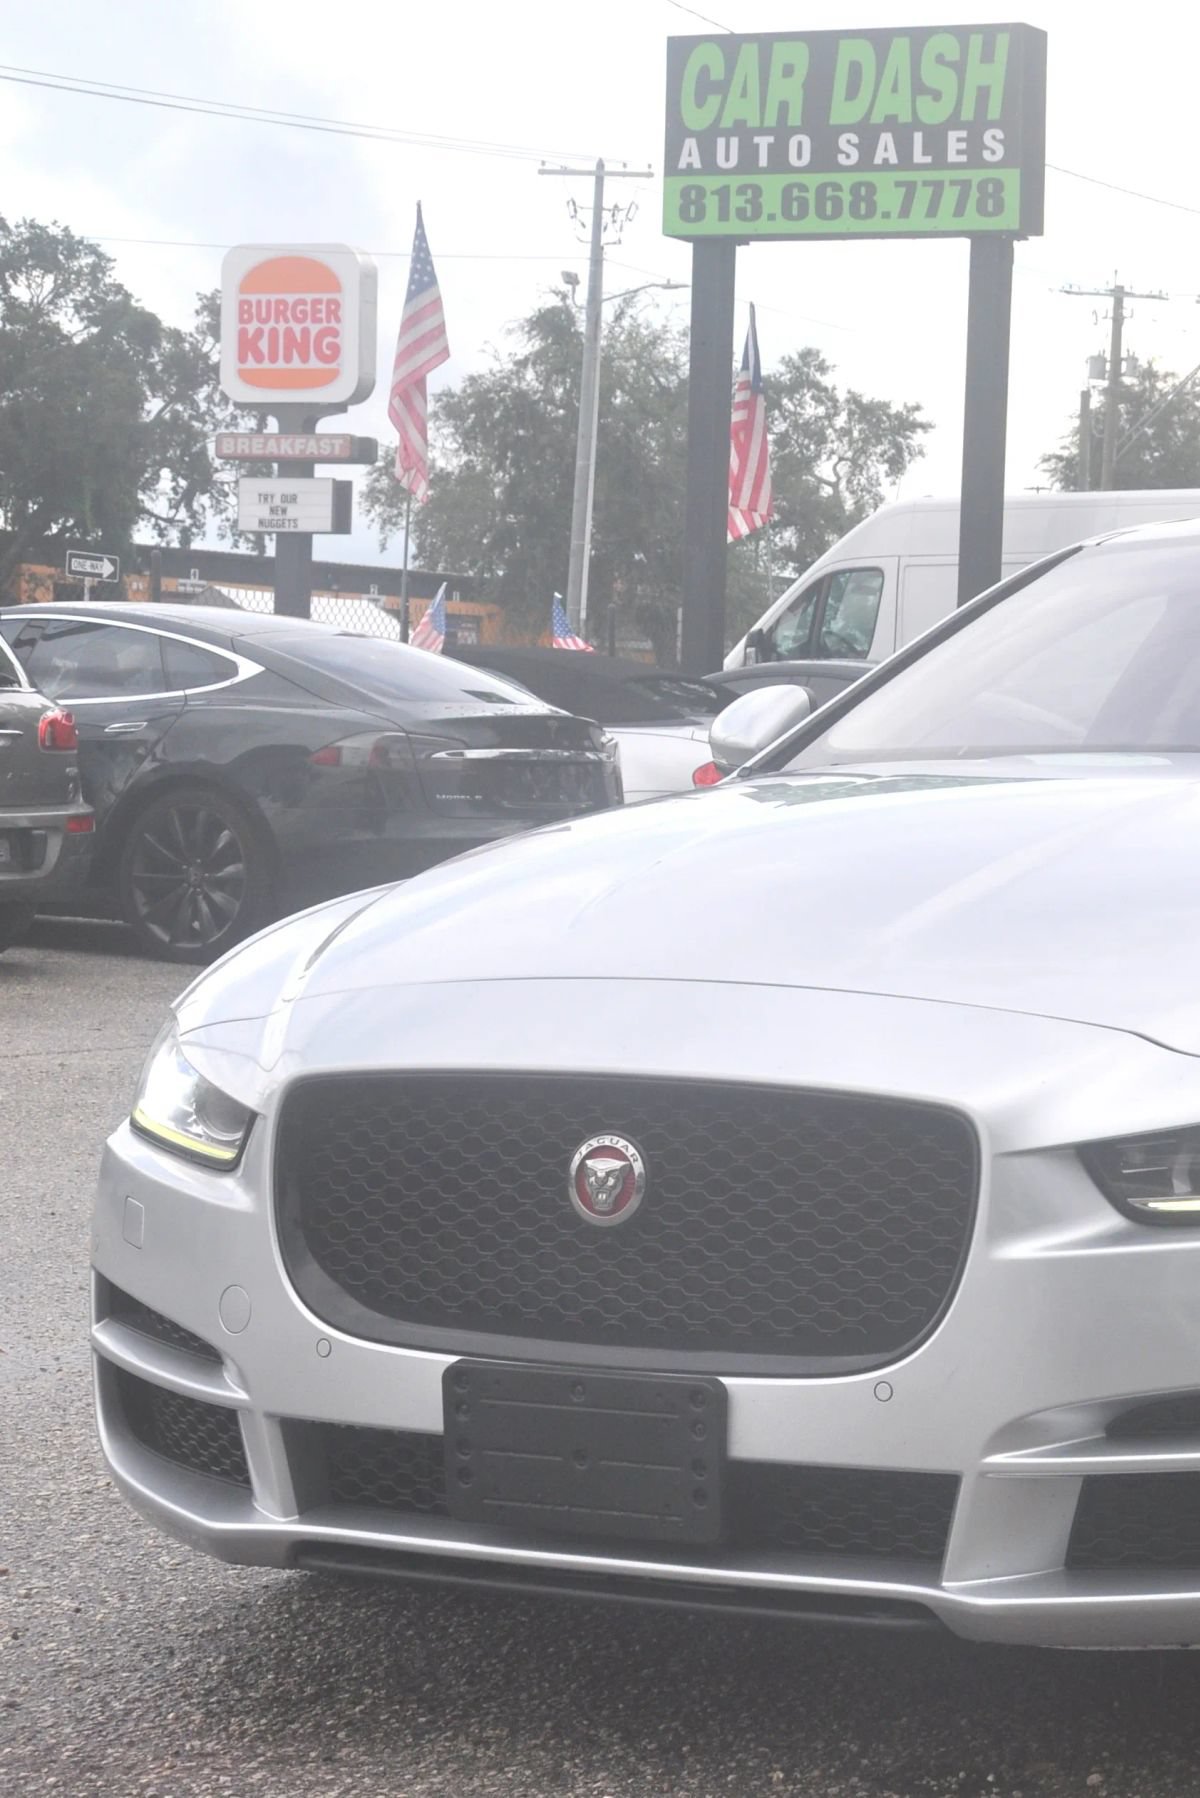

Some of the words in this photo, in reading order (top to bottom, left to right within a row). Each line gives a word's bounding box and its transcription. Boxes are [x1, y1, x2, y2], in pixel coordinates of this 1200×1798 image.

[679, 41, 810, 131] CAR
[829, 32, 1011, 125] DASH
[677, 134, 812, 170] AUTO
[836, 128, 1006, 166] SALES
[678, 177, 1006, 224] 813.668.7778
[238, 298, 342, 325] BURGER
[238, 326, 342, 365] KING
[221, 437, 345, 456] BREAKFAST
[257, 493, 273, 505] TRY
[280, 493, 298, 505] OUR
[269, 506, 288, 516] NEW
[257, 518, 299, 529] NUGGETS
[576, 1136, 640, 1164] JAGUAR
